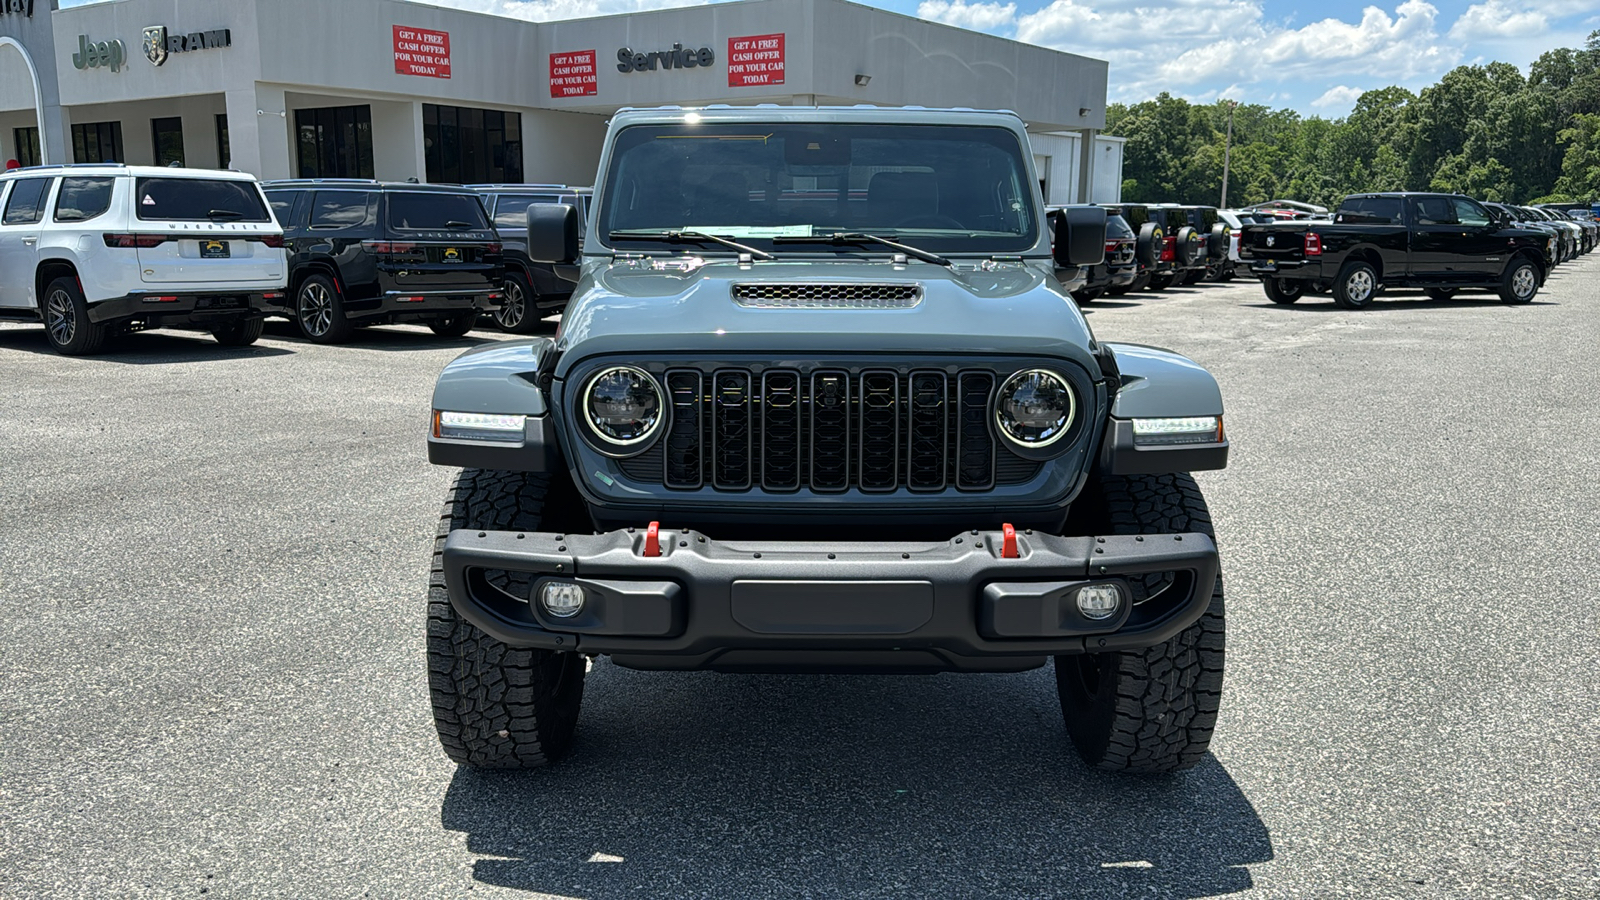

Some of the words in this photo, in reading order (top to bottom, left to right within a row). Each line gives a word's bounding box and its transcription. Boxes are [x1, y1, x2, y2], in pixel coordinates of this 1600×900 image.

[167, 29, 231, 53] RAM
[399, 31, 415, 40] GET
[417, 33, 423, 41] A
[424, 34, 444, 45] FREE
[398, 41, 419, 51] CASH
[420, 44, 446, 55] OFFER
[734, 41, 749, 50] GET
[751, 41, 757, 49] A
[758, 39, 779, 50] FREE
[72, 34, 127, 73] Jeep
[394, 52, 411, 61] FOR
[412, 54, 433, 64] YOUR
[434, 57, 450, 66] CAR
[617, 42, 715, 73] Service
[732, 53, 753, 62] CASH
[754, 51, 780, 61] OFFER
[554, 57, 567, 65] GET
[568, 56, 573, 64] A
[574, 55, 591, 64] FREE
[410, 65, 436, 75] TODAY
[553, 67, 570, 76] CASH
[571, 65, 592, 74] OFFER
[729, 65, 744, 74] FOR
[745, 63, 767, 72] YOUR
[768, 62, 784, 71] CAR
[550, 77, 563, 86] FOR
[564, 76, 582, 85] YOUR
[582, 75, 597, 84] CAR
[743, 74, 769, 83] TODAY
[563, 86, 584, 95] TODAY
